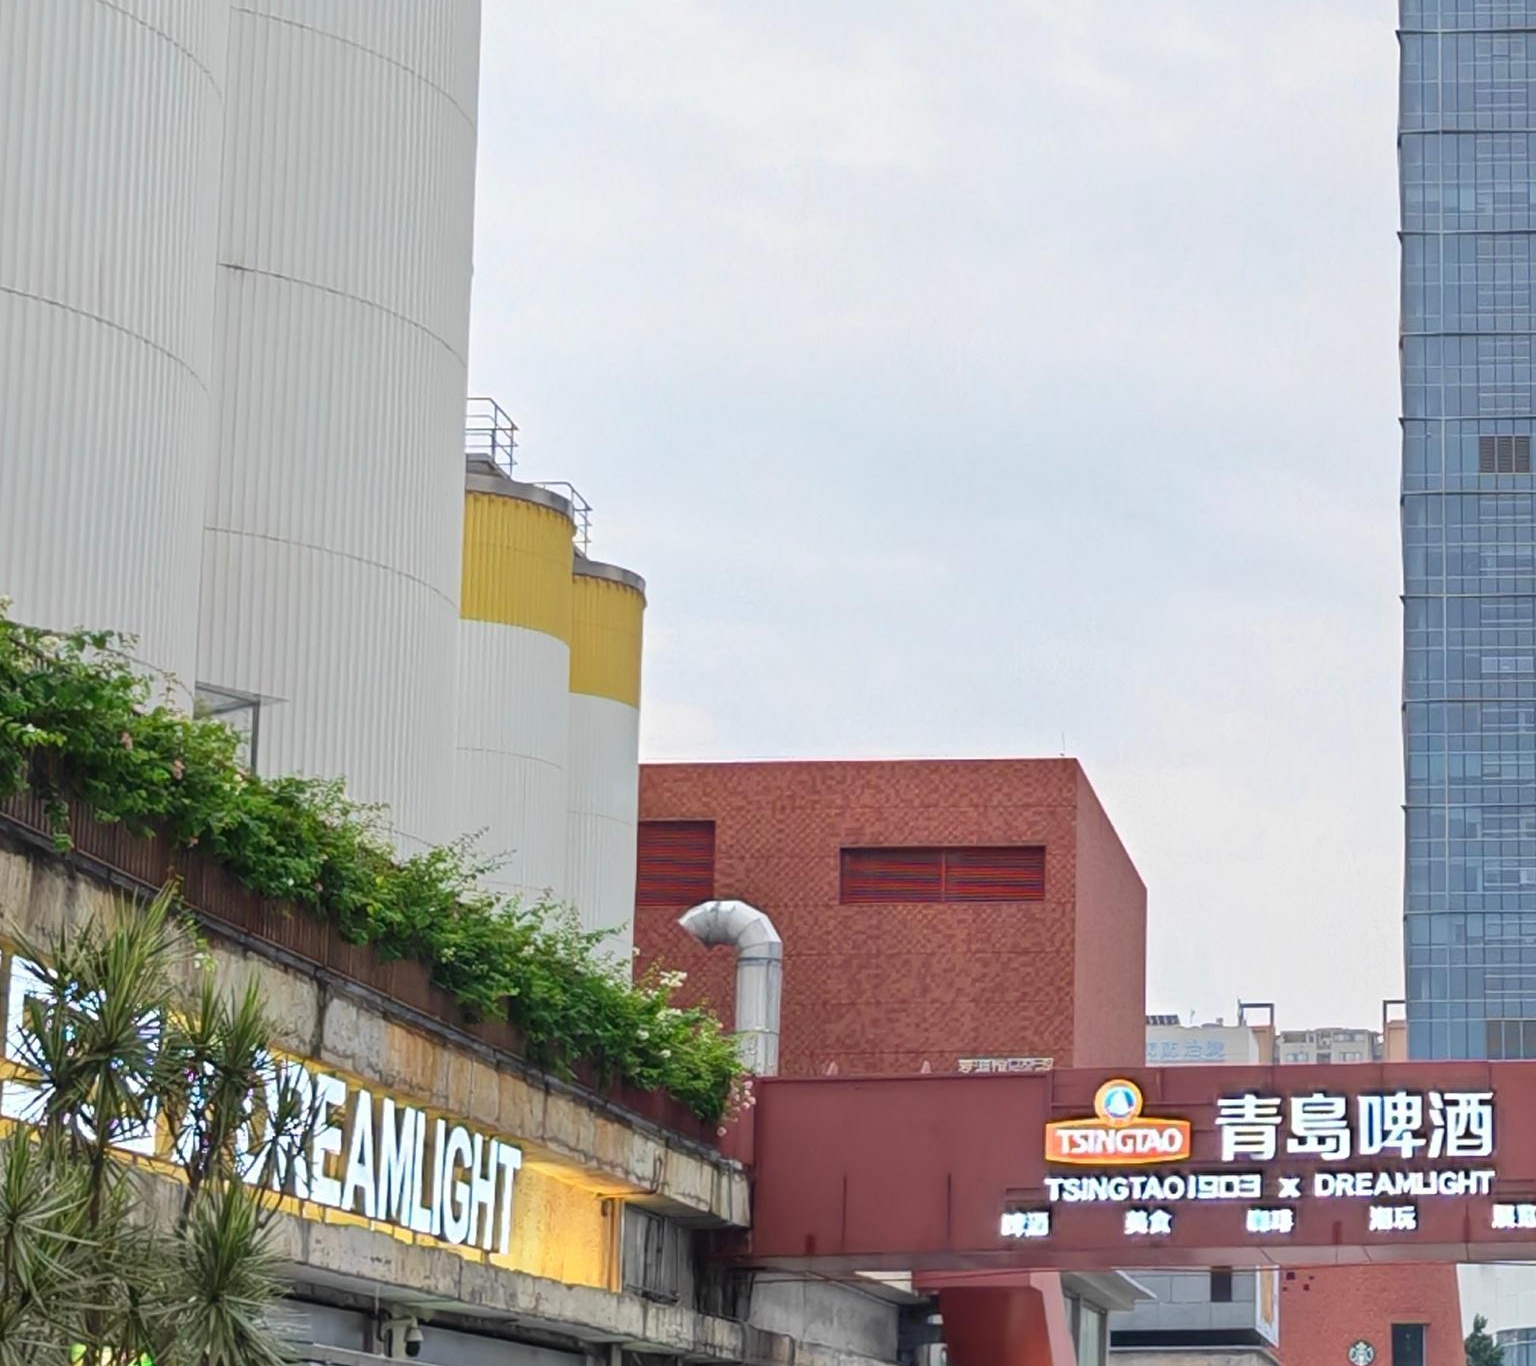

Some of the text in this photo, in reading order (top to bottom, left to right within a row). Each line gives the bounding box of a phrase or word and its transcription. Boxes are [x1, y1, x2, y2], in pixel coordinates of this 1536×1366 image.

[1216, 1091, 1495, 1162] 青岛啤酒
[1056, 1128, 1183, 1154] TSINGTAO
[1315, 1170, 1496, 1197] DREAMLIGHT
